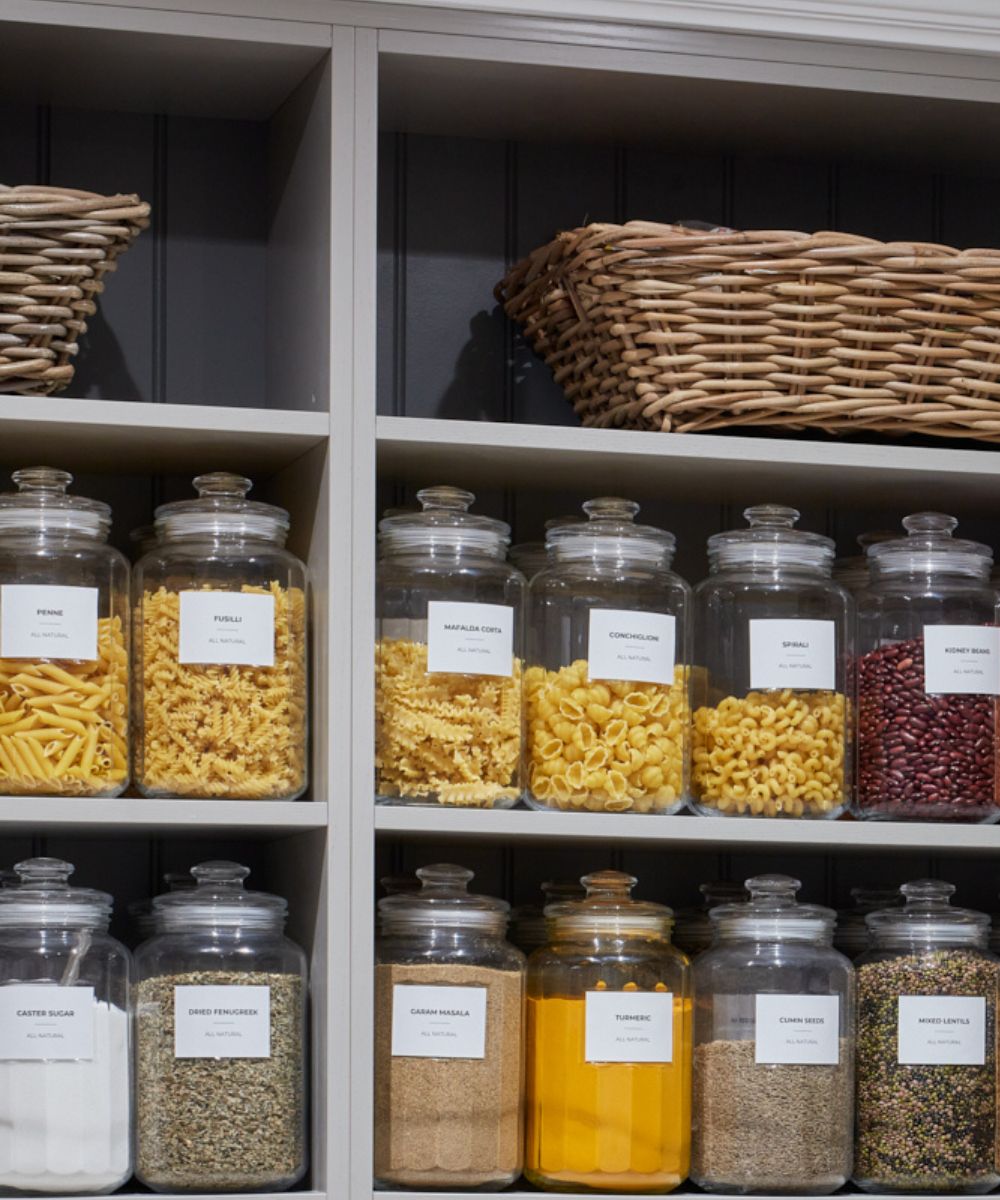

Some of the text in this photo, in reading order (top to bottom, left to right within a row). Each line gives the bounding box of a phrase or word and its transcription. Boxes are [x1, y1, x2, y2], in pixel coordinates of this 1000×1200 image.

[214, 615, 242, 623] FUSILLI
[444, 624, 502, 634] MAFALDA CORTA
[945, 647, 990, 655] KIDNEY BEANS
[189, 1008, 258, 1016] DRIED FENUGREEK
[439, 1009, 470, 1017] MASALA
[615, 1014, 651, 1022] TURMERIC
